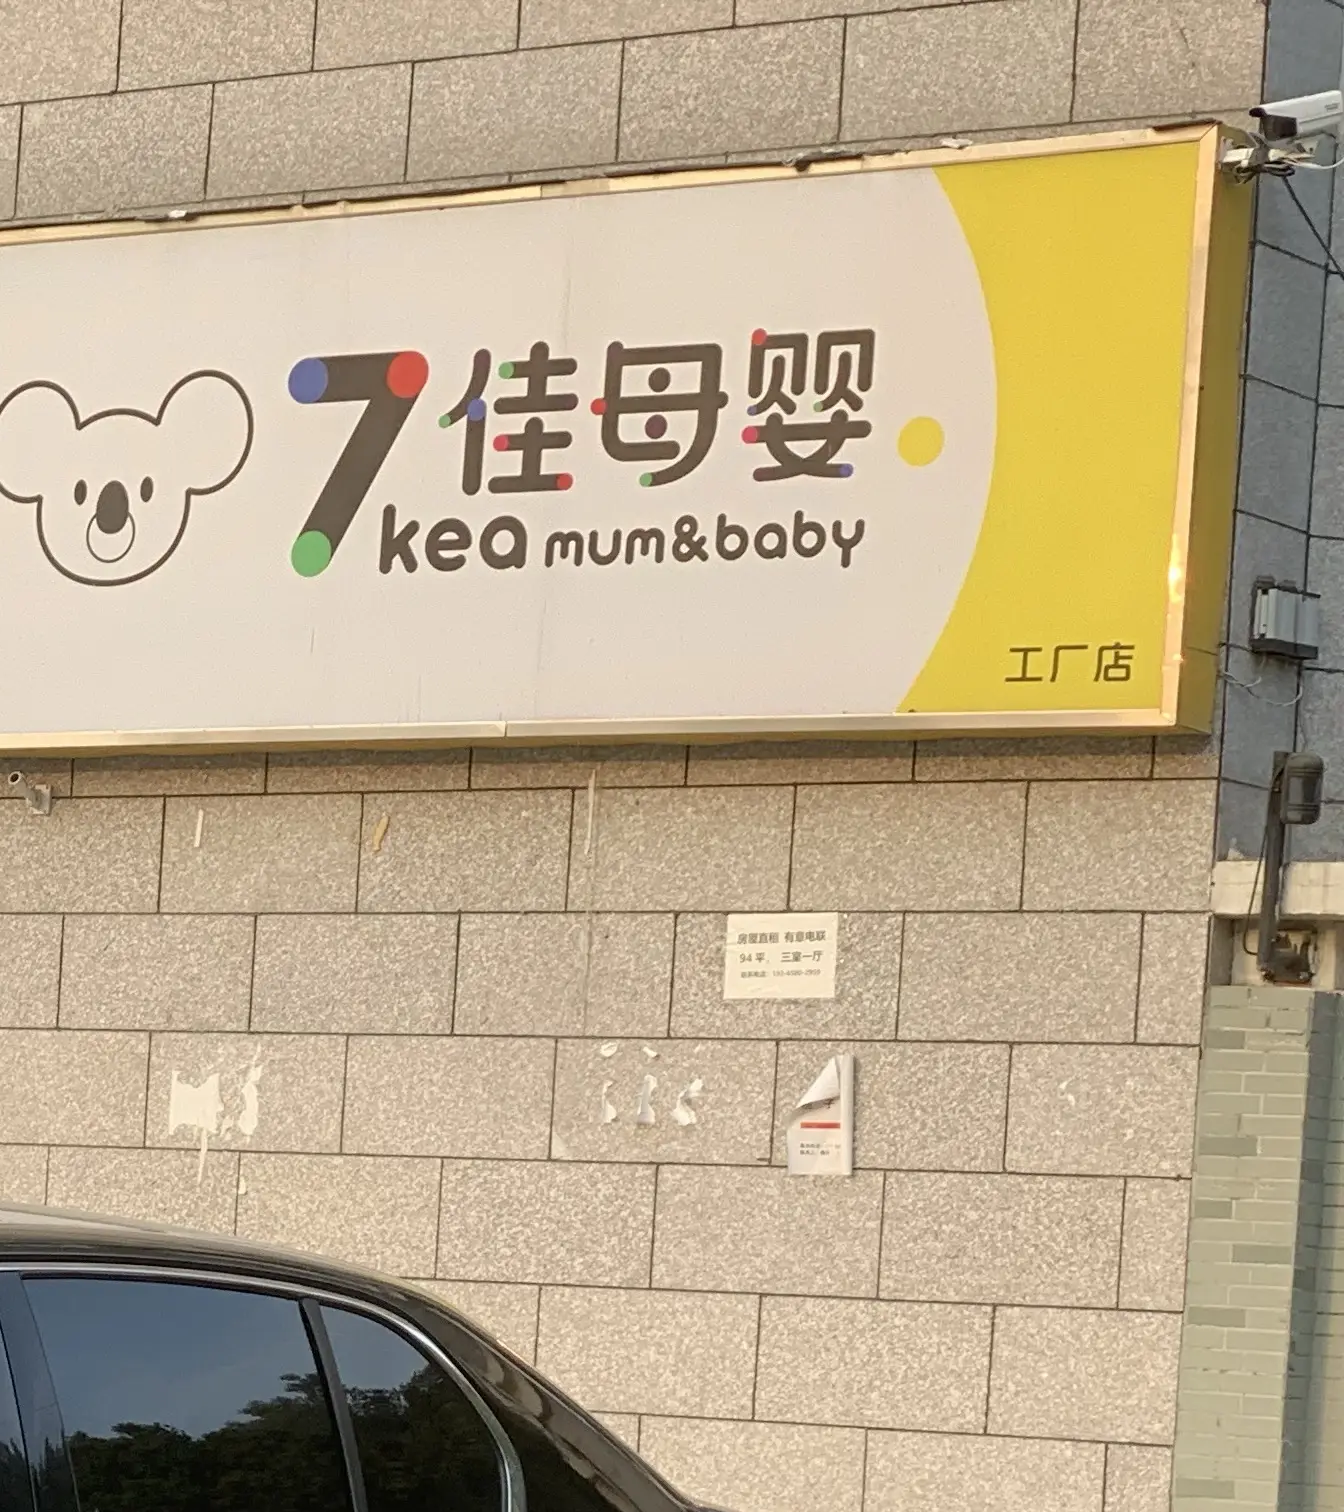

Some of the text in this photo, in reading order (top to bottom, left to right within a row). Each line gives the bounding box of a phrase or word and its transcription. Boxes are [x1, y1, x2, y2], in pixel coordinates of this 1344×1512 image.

[379, 503, 866, 575] kea mum&baby
[1004, 641, 1137, 684] 工厂店
[739, 953, 752, 963] 94
[781, 950, 823, 962] 三室一厅
